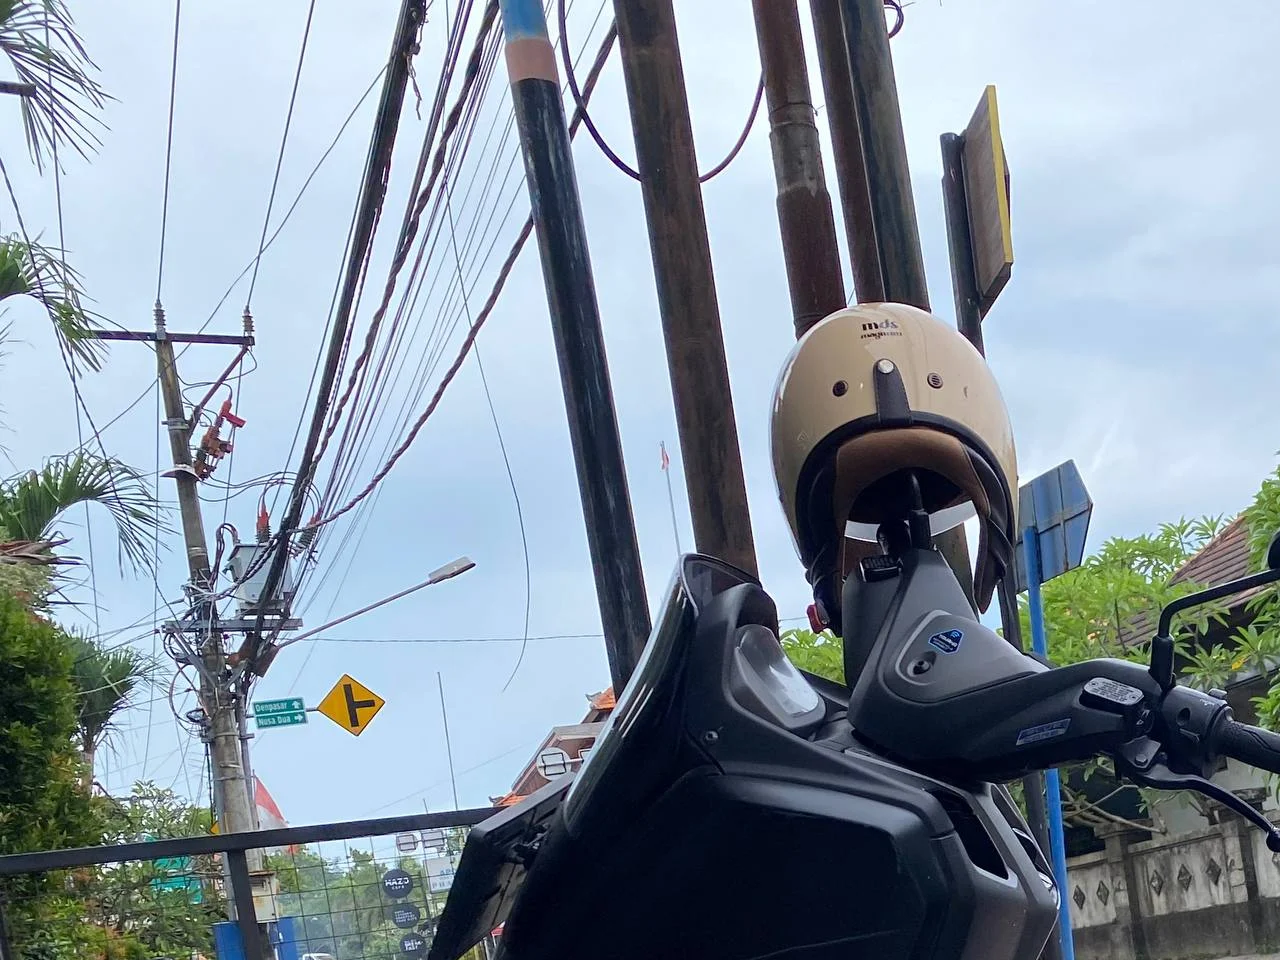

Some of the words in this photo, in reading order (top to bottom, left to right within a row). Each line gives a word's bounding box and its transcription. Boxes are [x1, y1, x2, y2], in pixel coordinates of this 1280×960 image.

[862, 319, 898, 330] mds
[255, 702, 287, 712] Denpasar
[258, 717, 275, 726] Nusa
[277, 715, 291, 724] Dua
